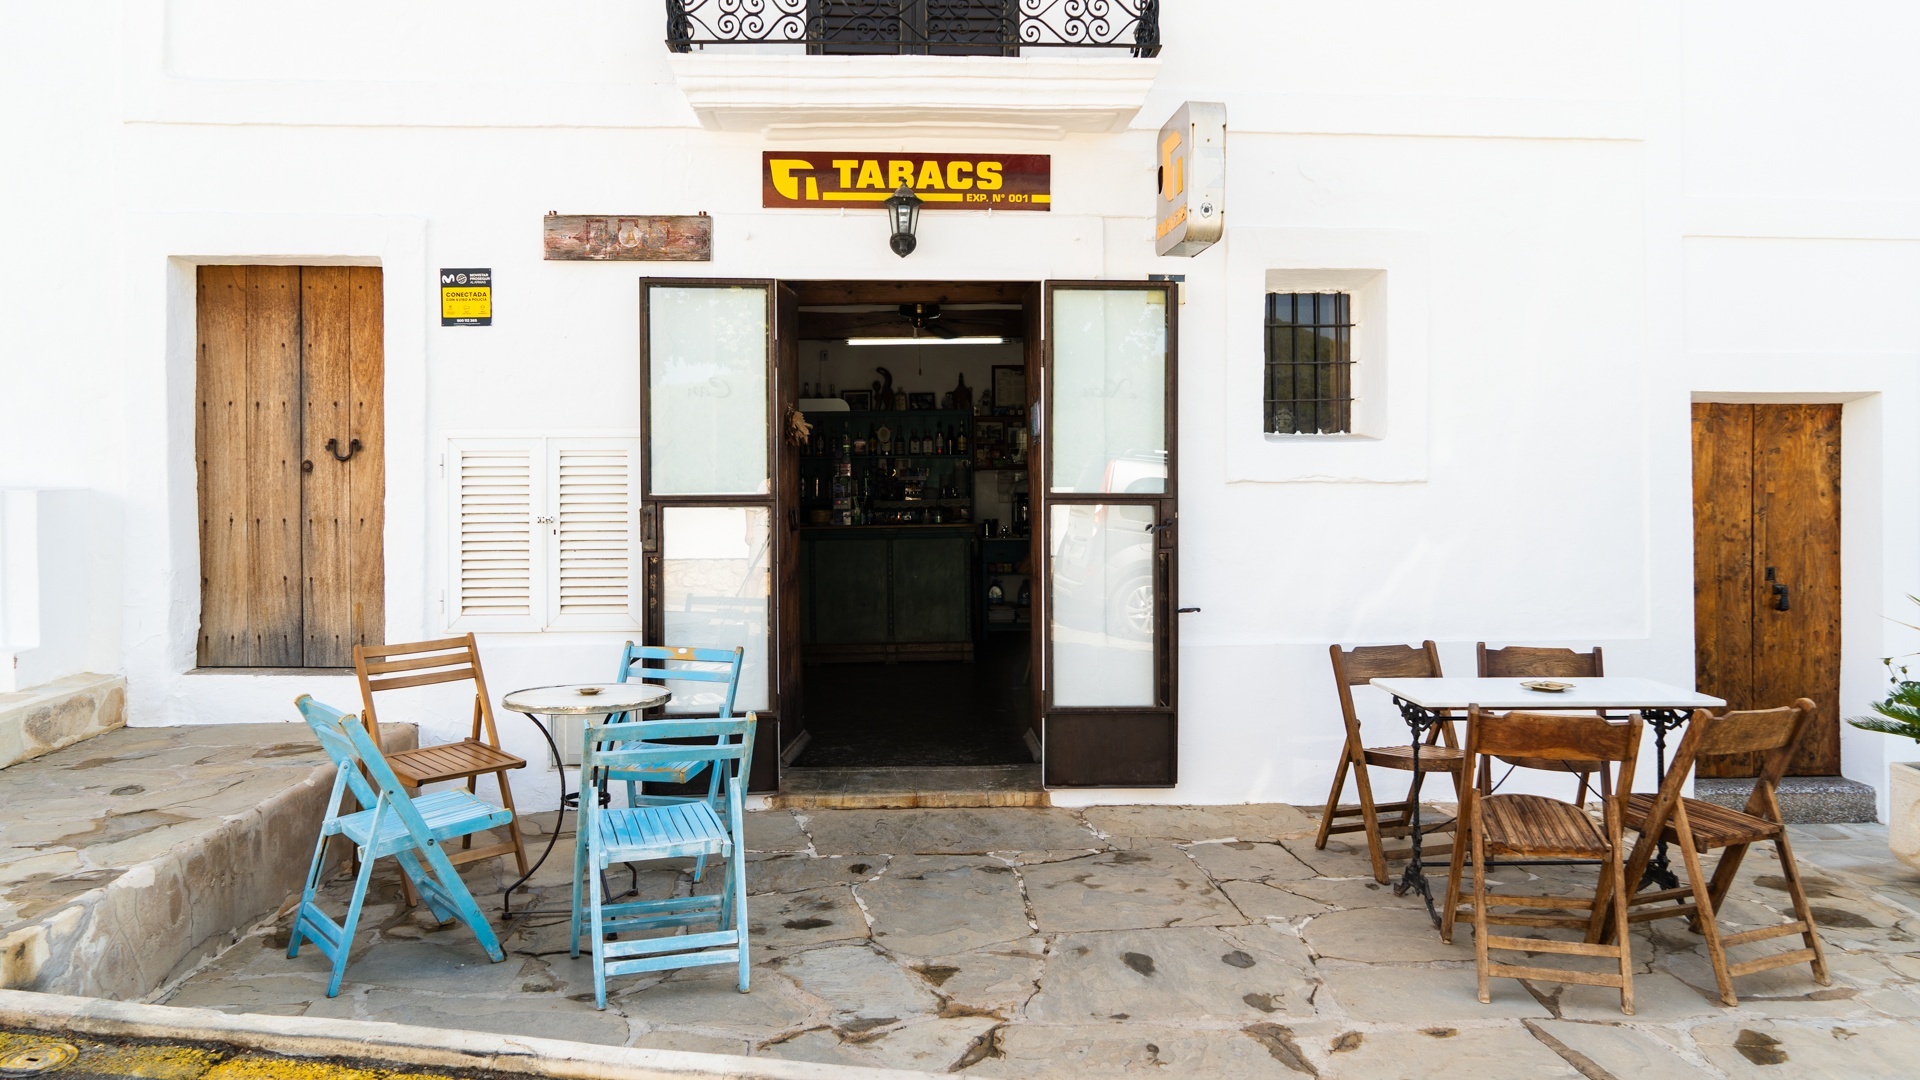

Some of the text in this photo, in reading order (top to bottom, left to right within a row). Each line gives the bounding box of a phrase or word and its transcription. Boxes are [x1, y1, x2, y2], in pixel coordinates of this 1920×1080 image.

[833, 159, 1003, 190] TABACS
[966, 193, 989, 203] EXP.
[1008, 194, 1029, 204] 001
